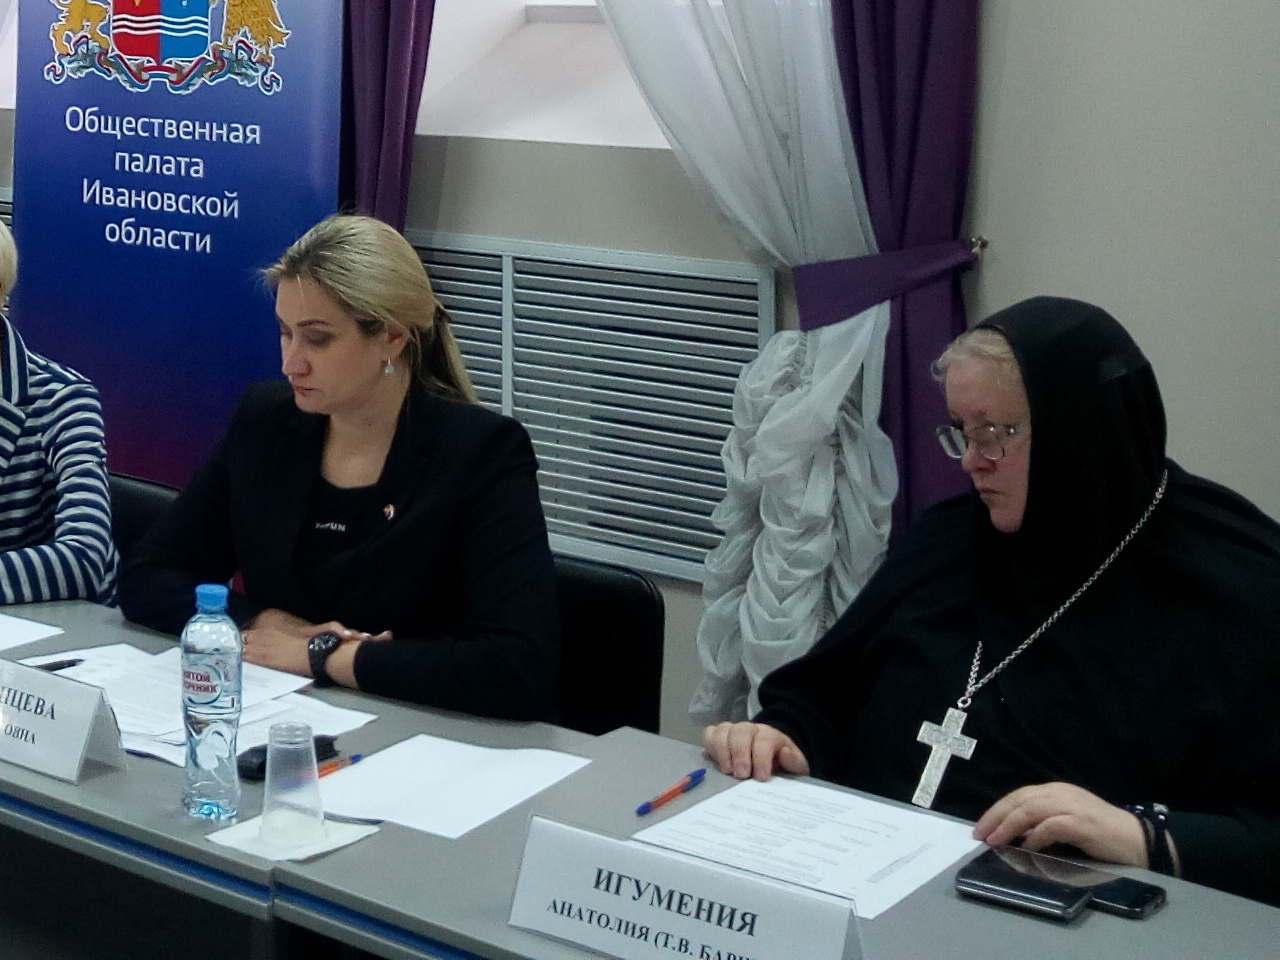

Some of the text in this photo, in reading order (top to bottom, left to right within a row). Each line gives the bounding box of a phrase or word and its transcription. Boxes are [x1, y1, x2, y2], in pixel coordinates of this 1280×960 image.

[65, 106, 262, 145] Общественная
[114, 151, 206, 179] палата
[82, 178, 241, 220] Ивановской
[105, 217, 212, 254] области
[546, 898, 652, 944] АНАТОЛИЯ
[593, 867, 760, 938] ИГУМЕНИЯ
